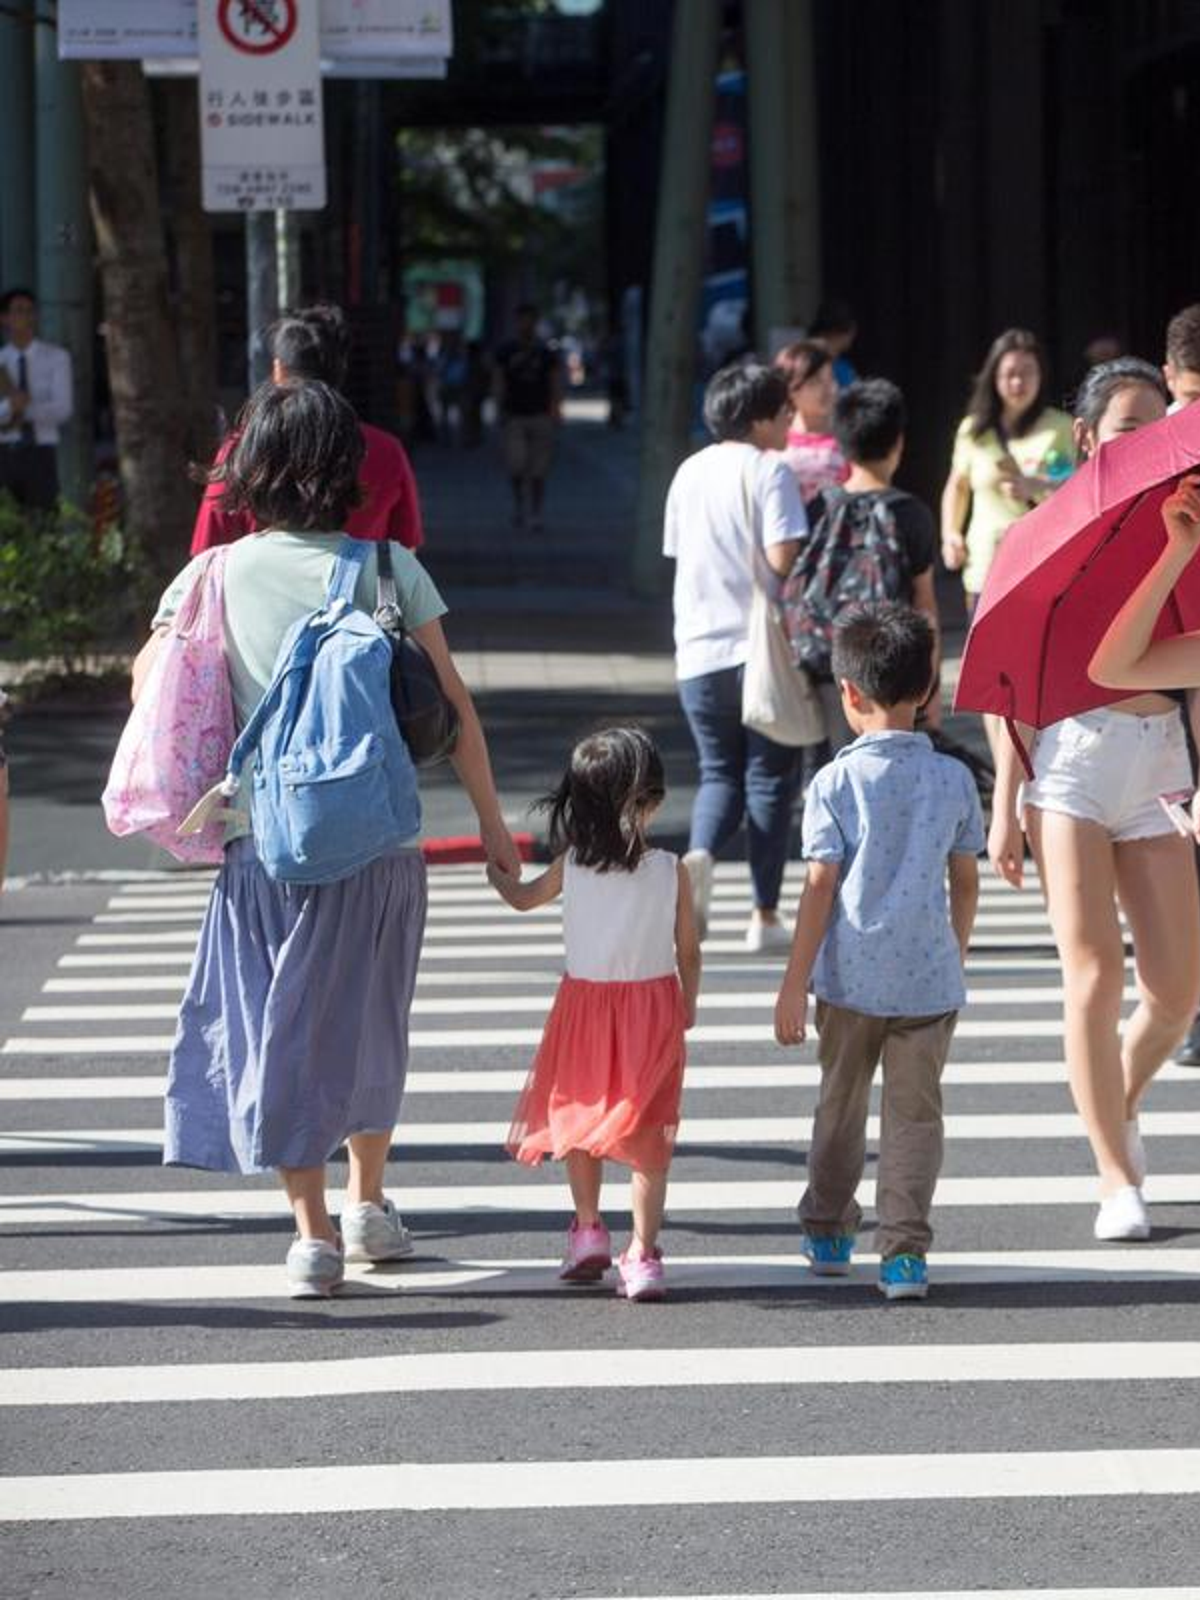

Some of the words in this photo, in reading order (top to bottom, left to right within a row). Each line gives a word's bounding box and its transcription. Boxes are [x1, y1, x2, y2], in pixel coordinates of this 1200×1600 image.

[208, 89, 315, 108] 行人徒步區
[228, 112, 316, 127] SIDEWALK
